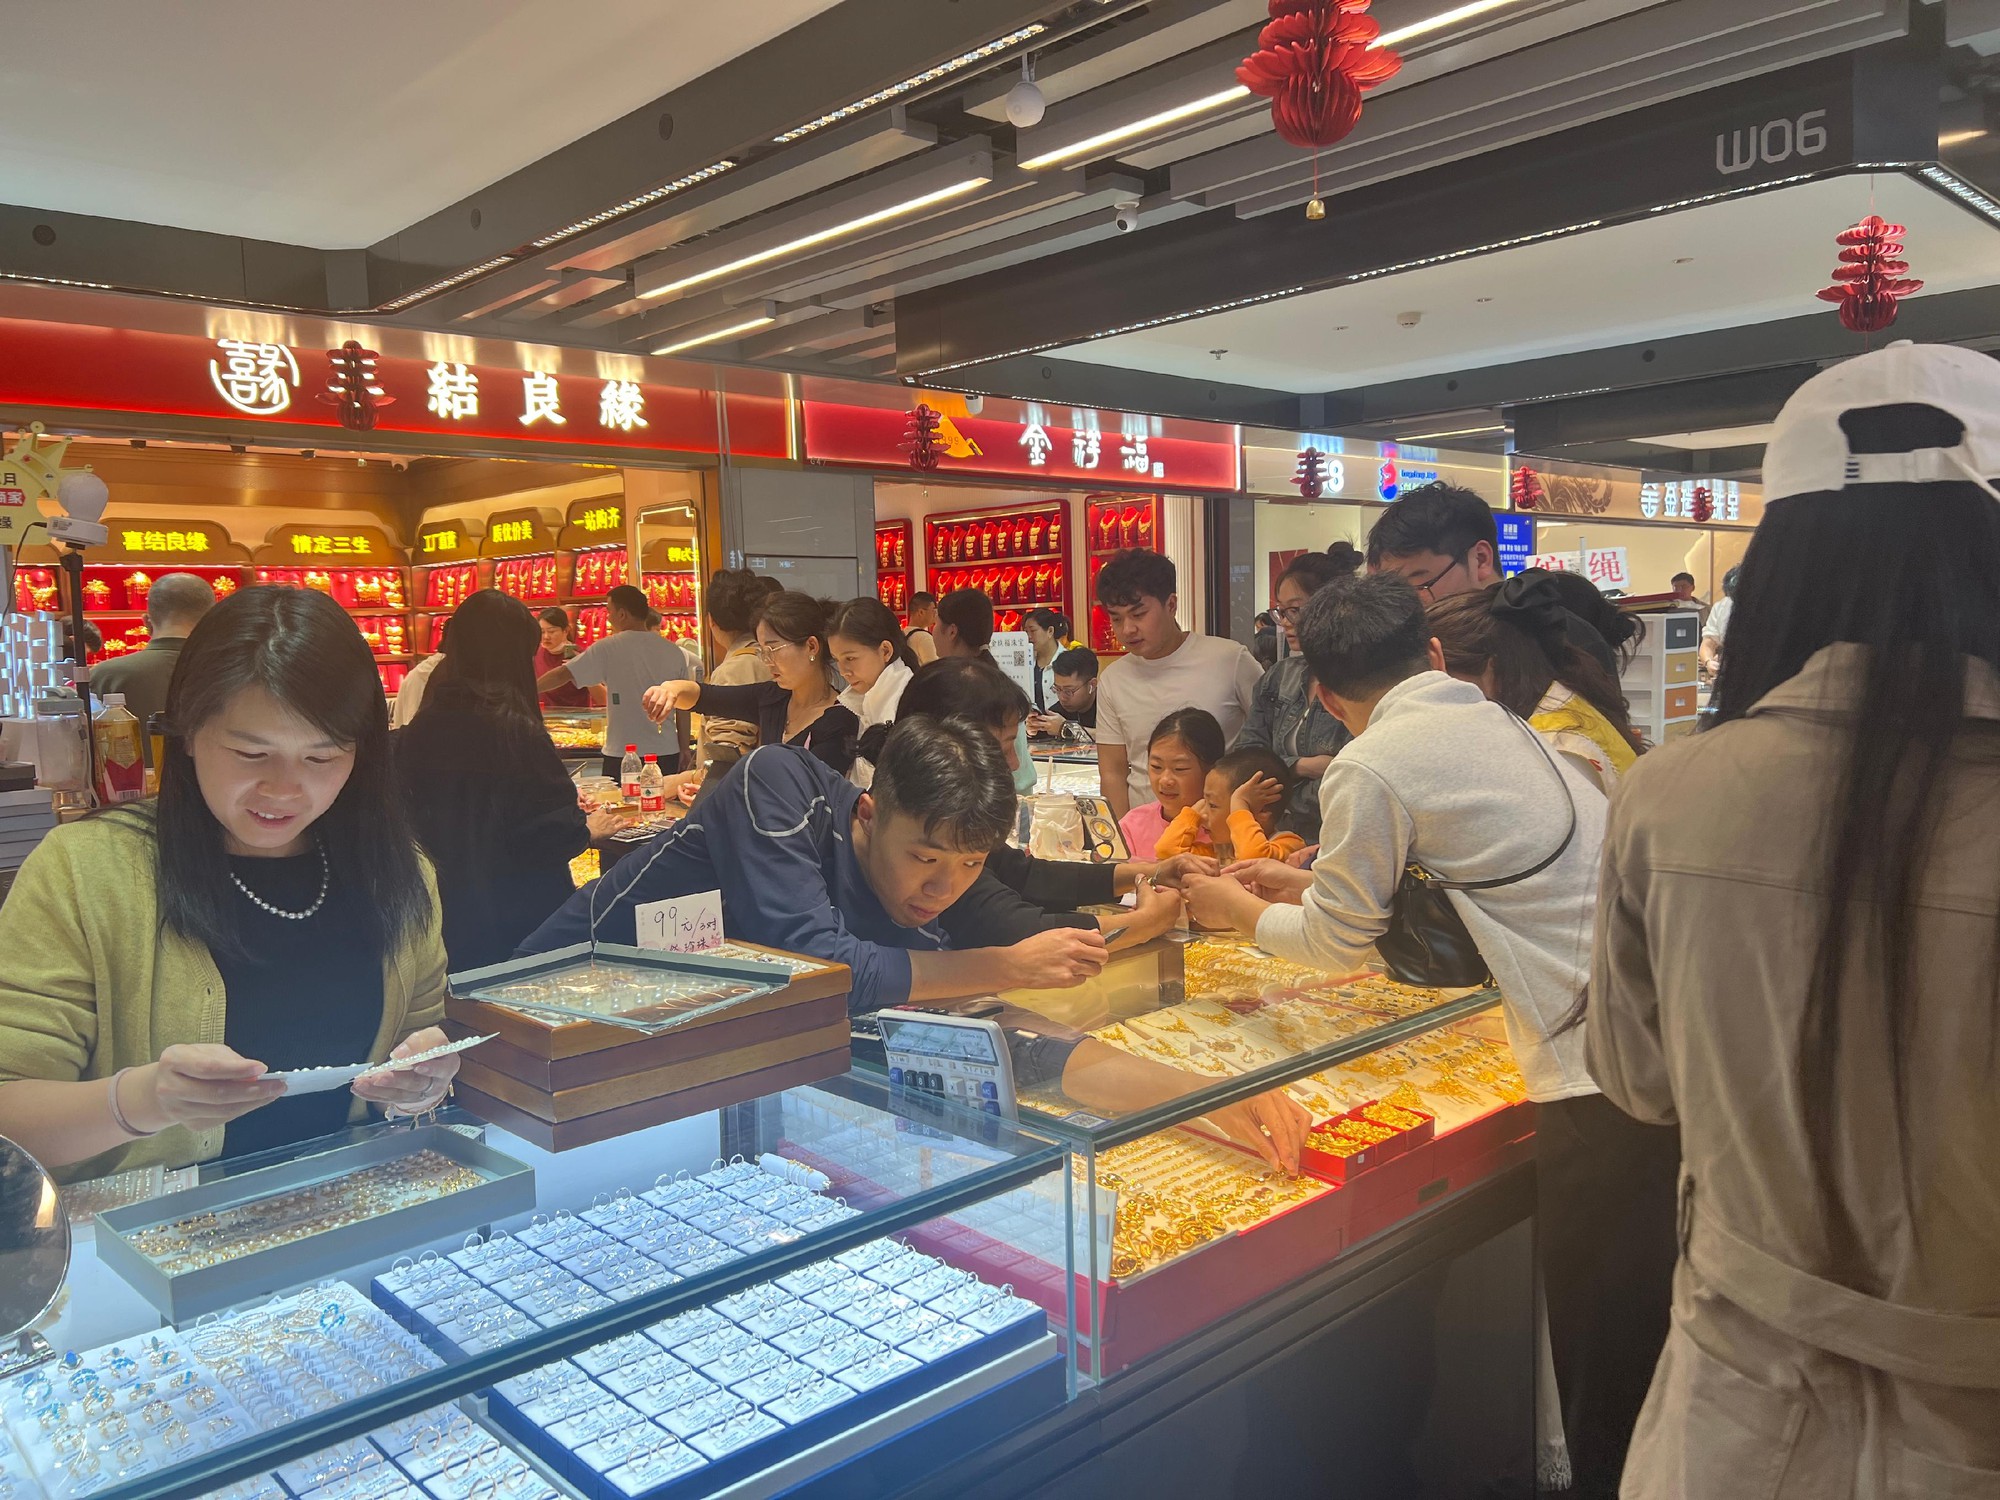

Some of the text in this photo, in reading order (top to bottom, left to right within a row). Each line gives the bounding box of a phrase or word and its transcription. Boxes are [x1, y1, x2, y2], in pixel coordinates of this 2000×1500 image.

[1715, 109, 1827, 175] W06
[572, 506, 621, 532] 一站购齐
[121, 531, 210, 552] 喜结良缘
[291, 534, 372, 554] 情定三生
